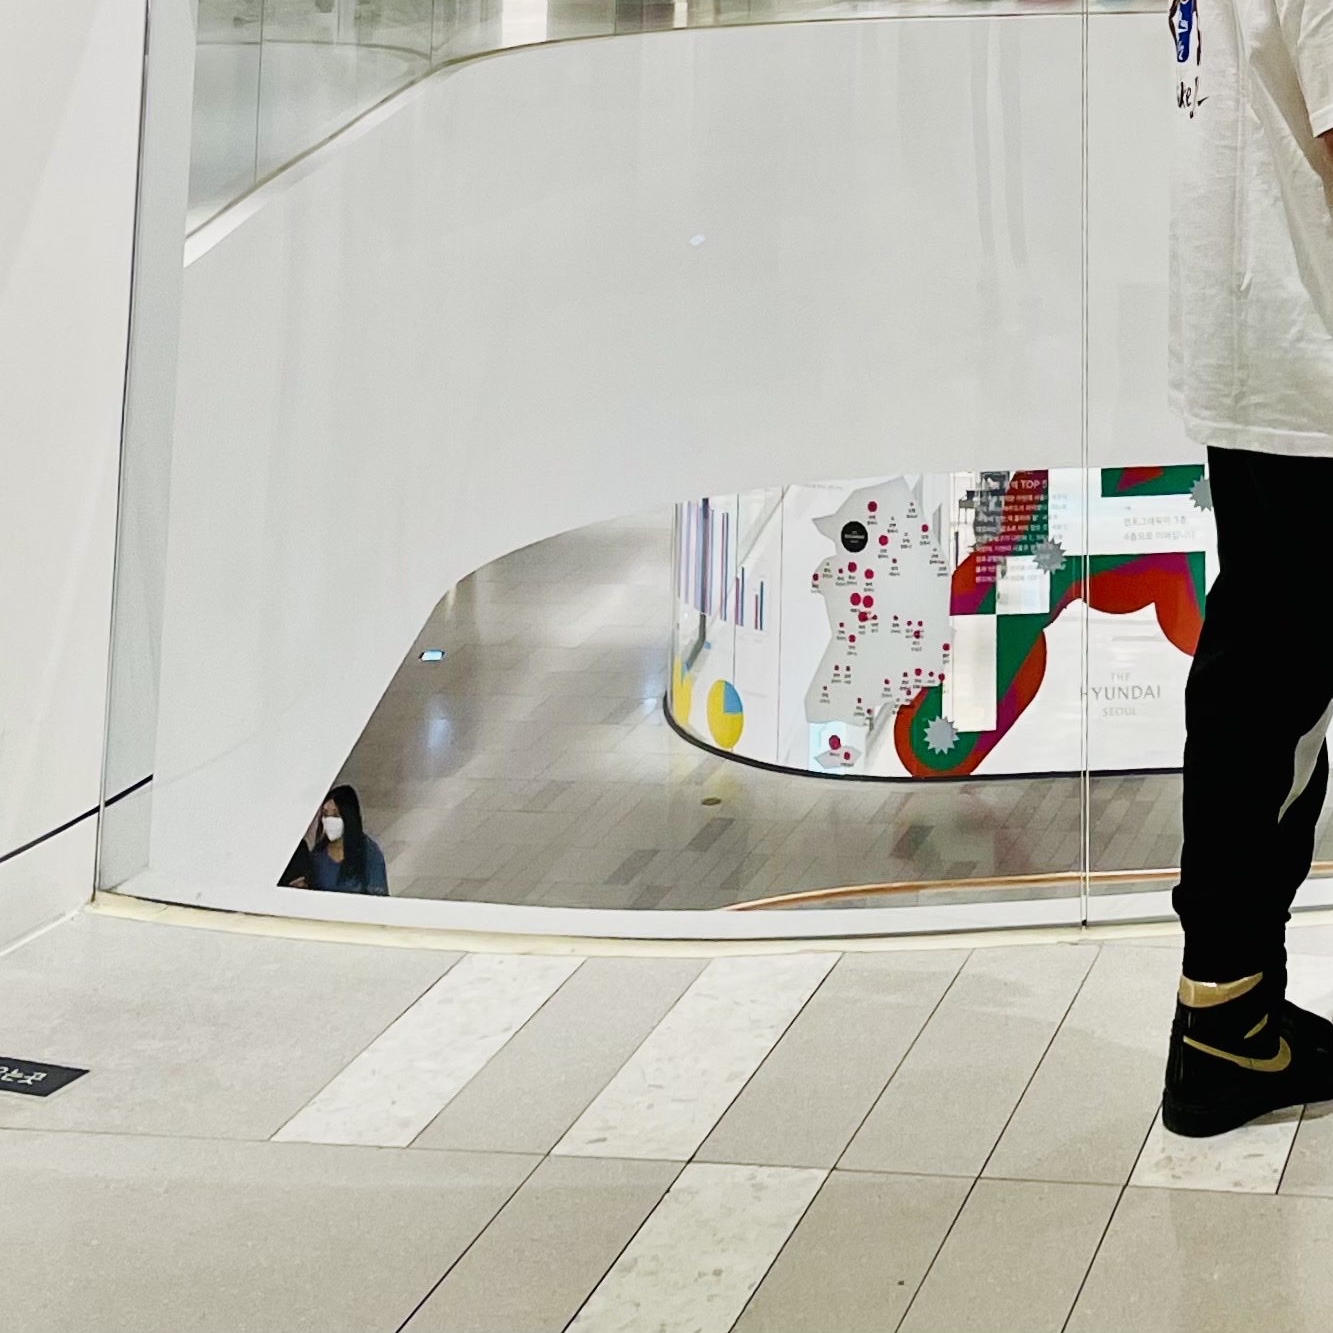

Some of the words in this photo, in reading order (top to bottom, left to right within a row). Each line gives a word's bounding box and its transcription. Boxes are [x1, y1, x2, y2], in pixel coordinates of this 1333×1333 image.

[1020, 479, 1040, 489] TOP
[1111, 672, 1131, 682] THE
[1103, 706, 1137, 717] SEOUL
